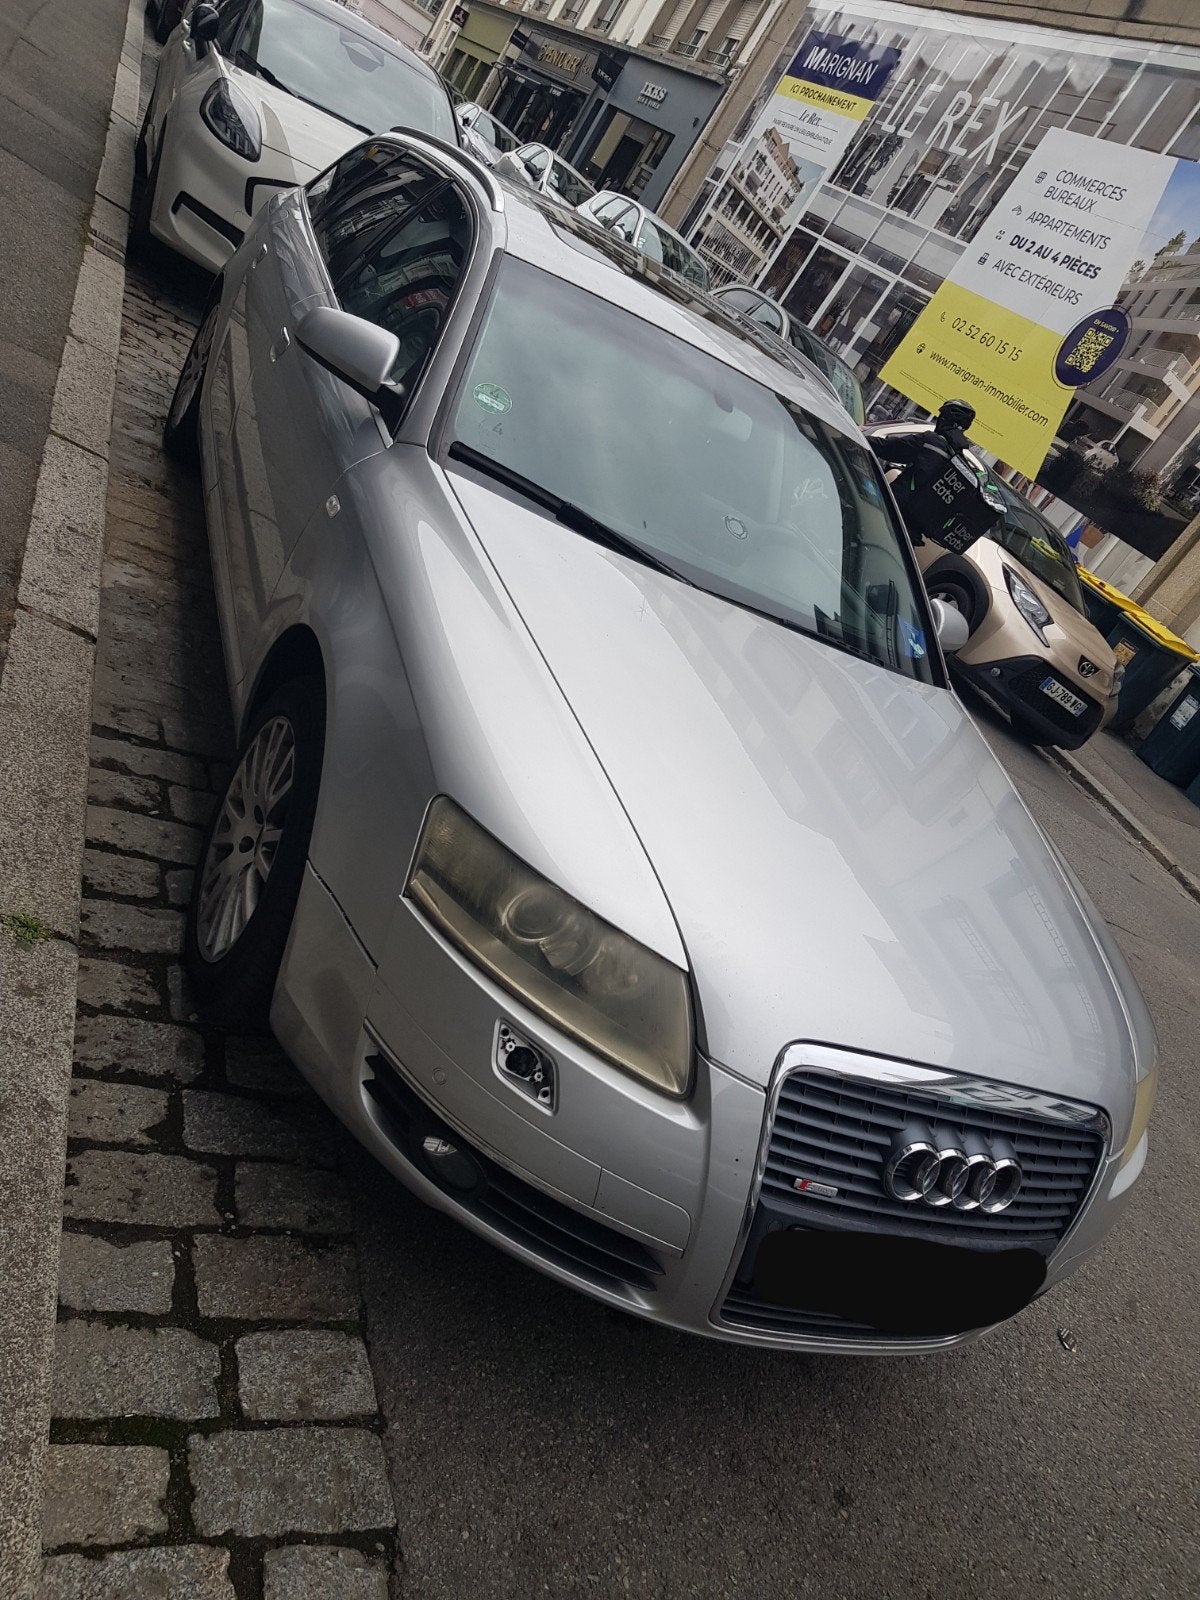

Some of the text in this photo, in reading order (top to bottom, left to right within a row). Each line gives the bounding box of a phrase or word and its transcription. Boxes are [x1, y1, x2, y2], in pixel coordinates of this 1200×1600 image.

[803, 46, 878, 85] MARIGNAN
[790, 85, 857, 111] ICI PROCHAINEMENT
[881, 79, 1028, 166] LE REX
[1043, 186, 1098, 213] BUREAUX
[1055, 170, 1127, 201] COMMERCES
[1026, 211, 1111, 250] APPARTEMENTS
[1009, 234, 1101, 279] DU 2 AU 4 PIÈCES
[992, 259, 1083, 306] AVEC EXTÉRIEURS
[951, 317, 1022, 362] 02 52 60 15 15
[930, 350, 1049, 427] www.marignan-immobilier.com
[932, 479, 954, 504] Eats
[943, 467, 966, 493] Uber
[944, 532, 963, 550] Eats
[954, 523, 974, 541] Uber
